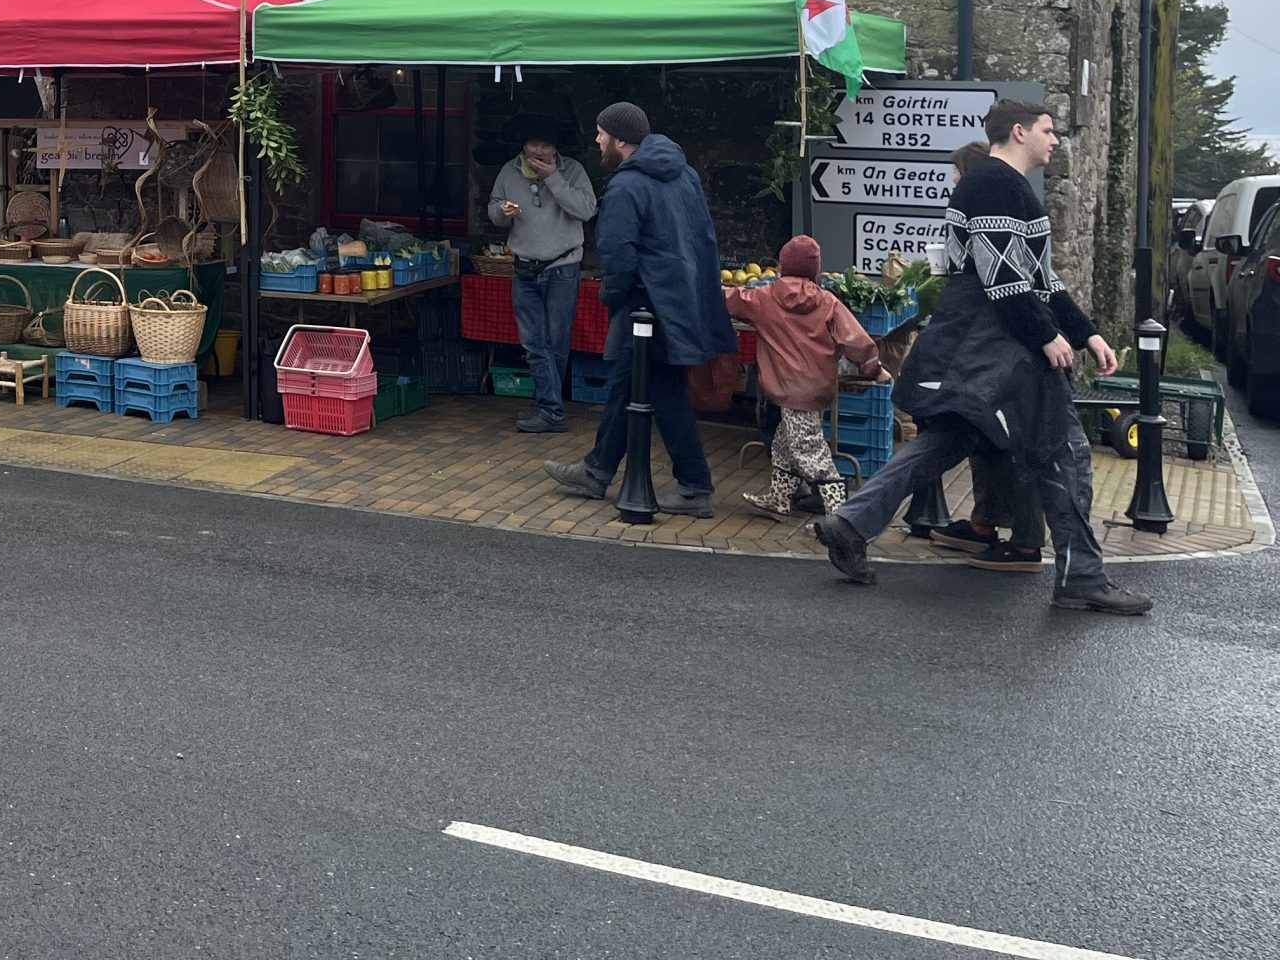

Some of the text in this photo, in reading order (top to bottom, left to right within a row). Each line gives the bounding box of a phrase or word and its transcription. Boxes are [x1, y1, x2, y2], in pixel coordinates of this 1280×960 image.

[855, 95, 949, 110] km Goirtíní
[854, 112, 987, 128] 14 GORTEENY
[882, 132, 931, 147] R352
[837, 165, 856, 175] km
[893, 167, 947, 182] Geata
[841, 182, 852, 196] 5
[863, 238, 945, 254] SCARR
